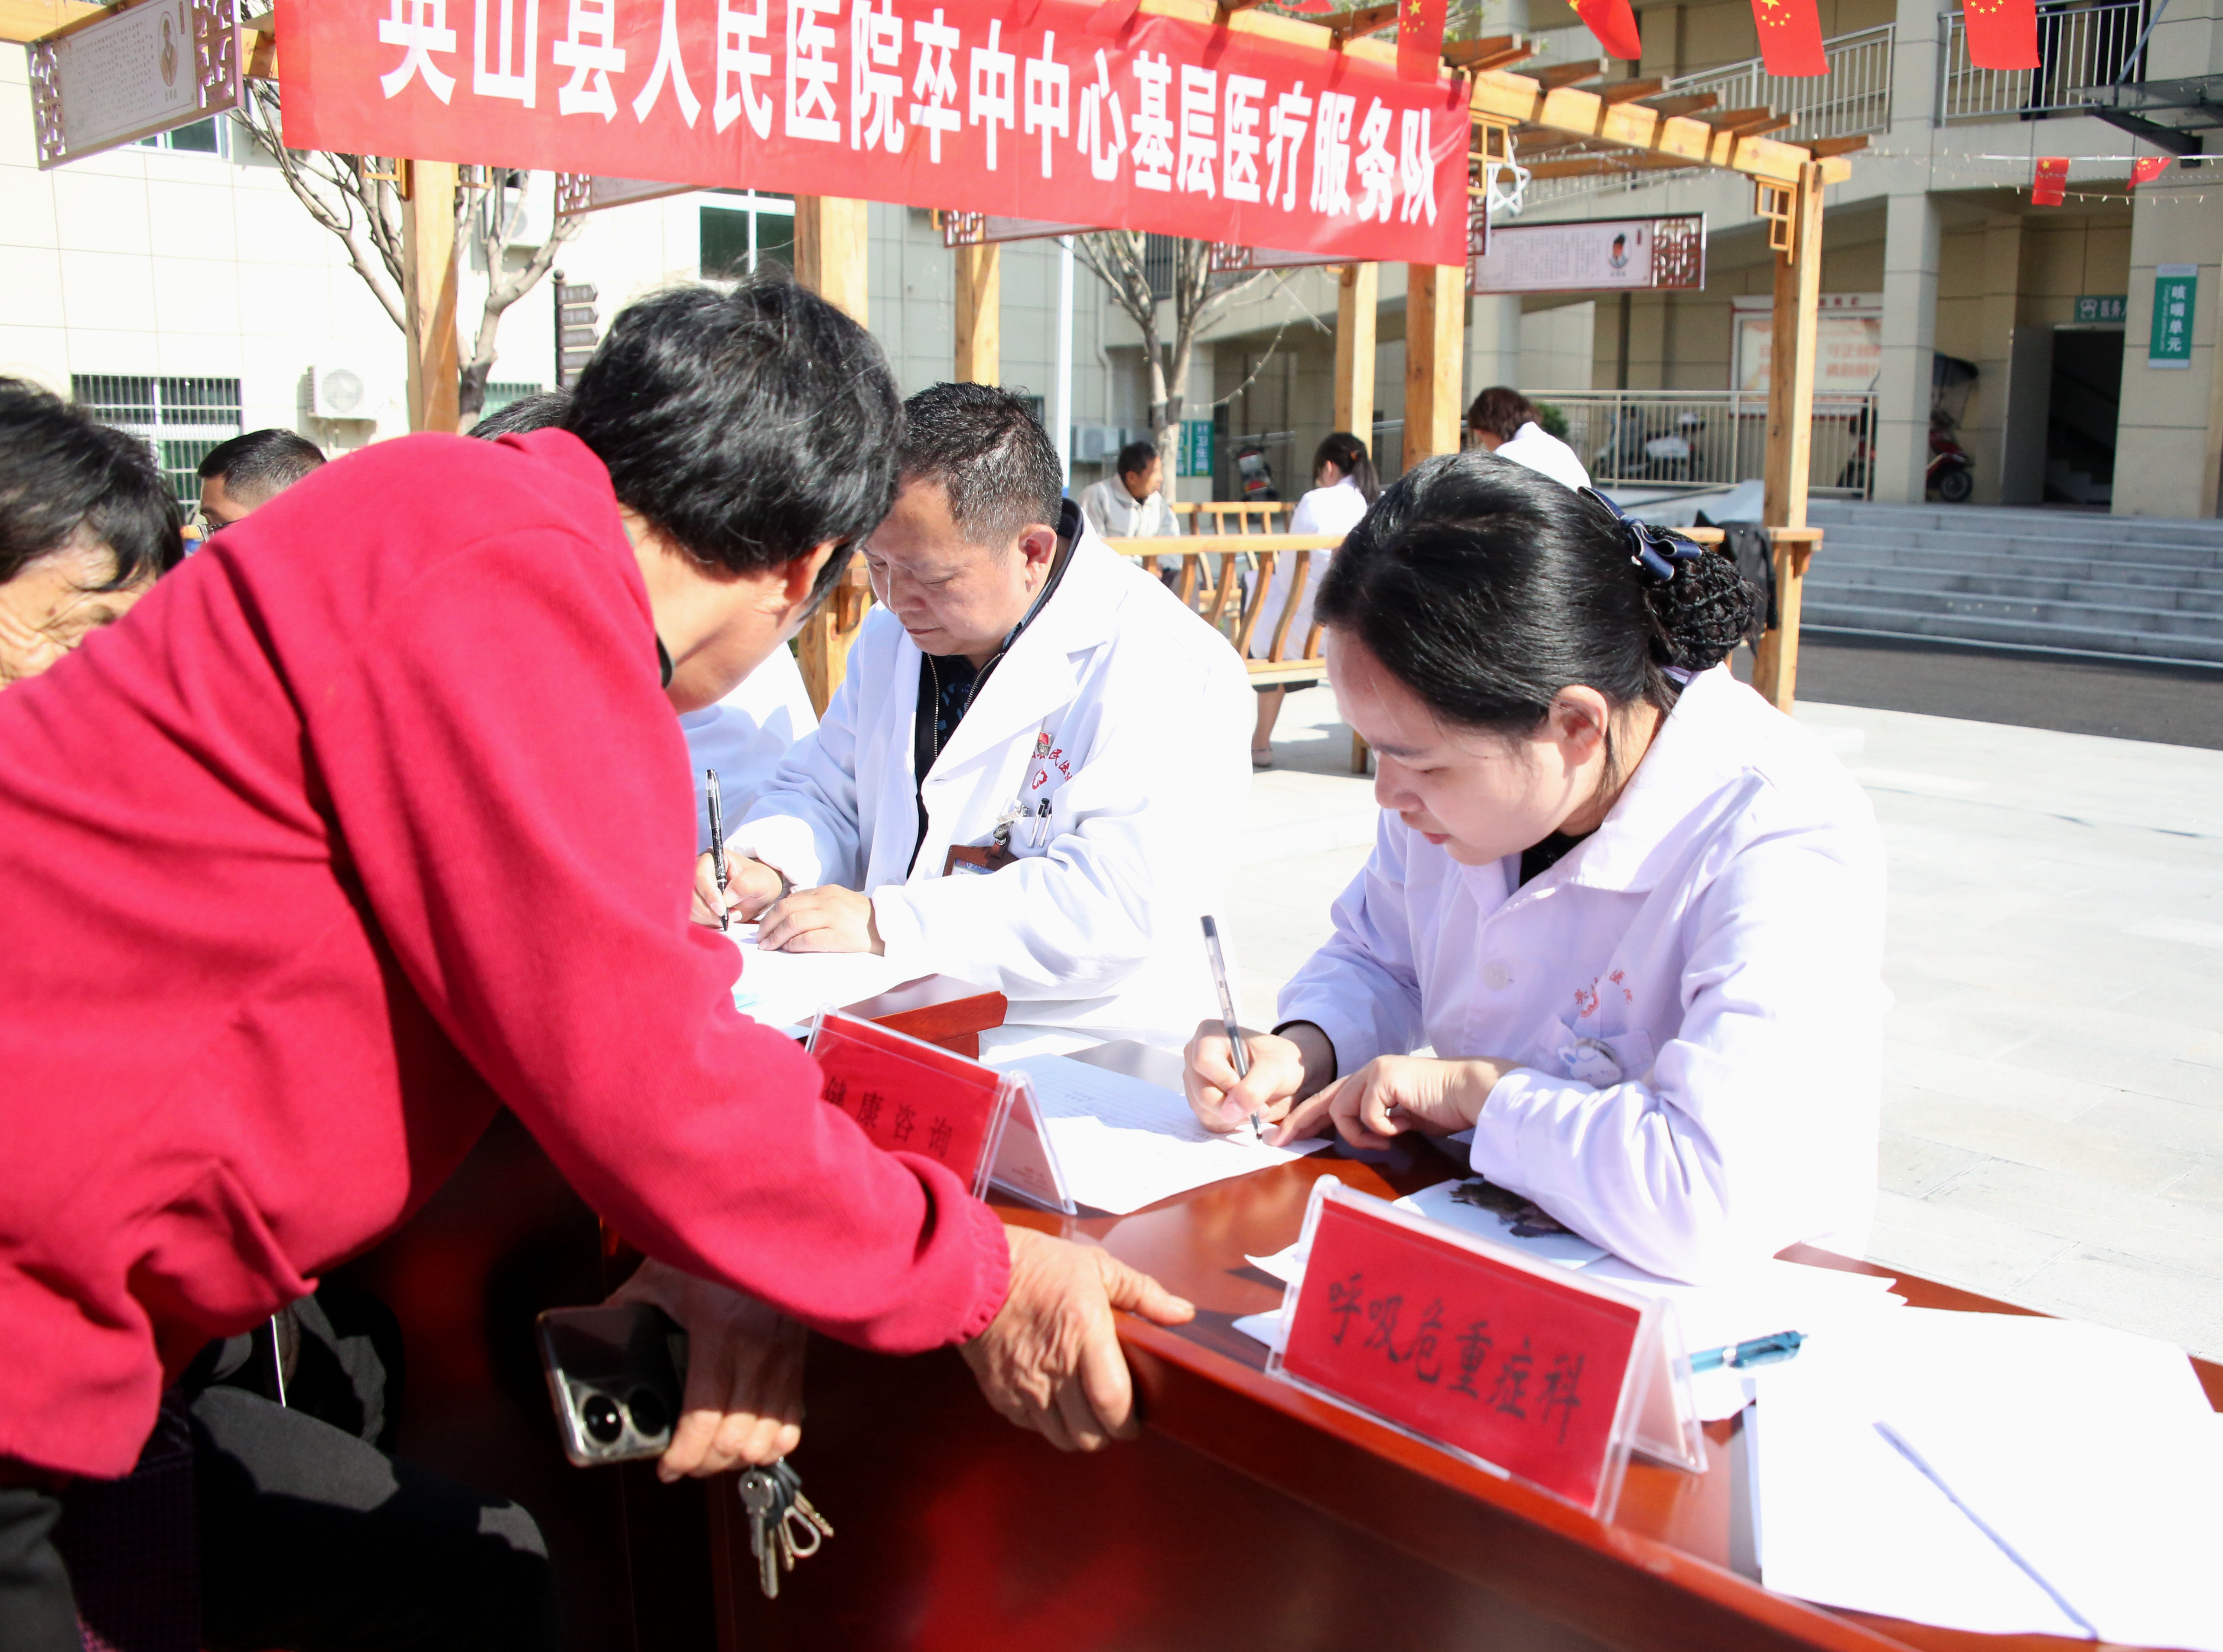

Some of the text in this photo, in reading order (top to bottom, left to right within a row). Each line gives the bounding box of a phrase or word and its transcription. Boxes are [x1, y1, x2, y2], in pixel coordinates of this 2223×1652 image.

[378, 0, 1439, 227] 英山县人民医院卒中中心基层医疗服务队
[821, 1076, 953, 1158] 健康咨询
[1328, 1272, 1586, 1445] 呼吸危重症科
